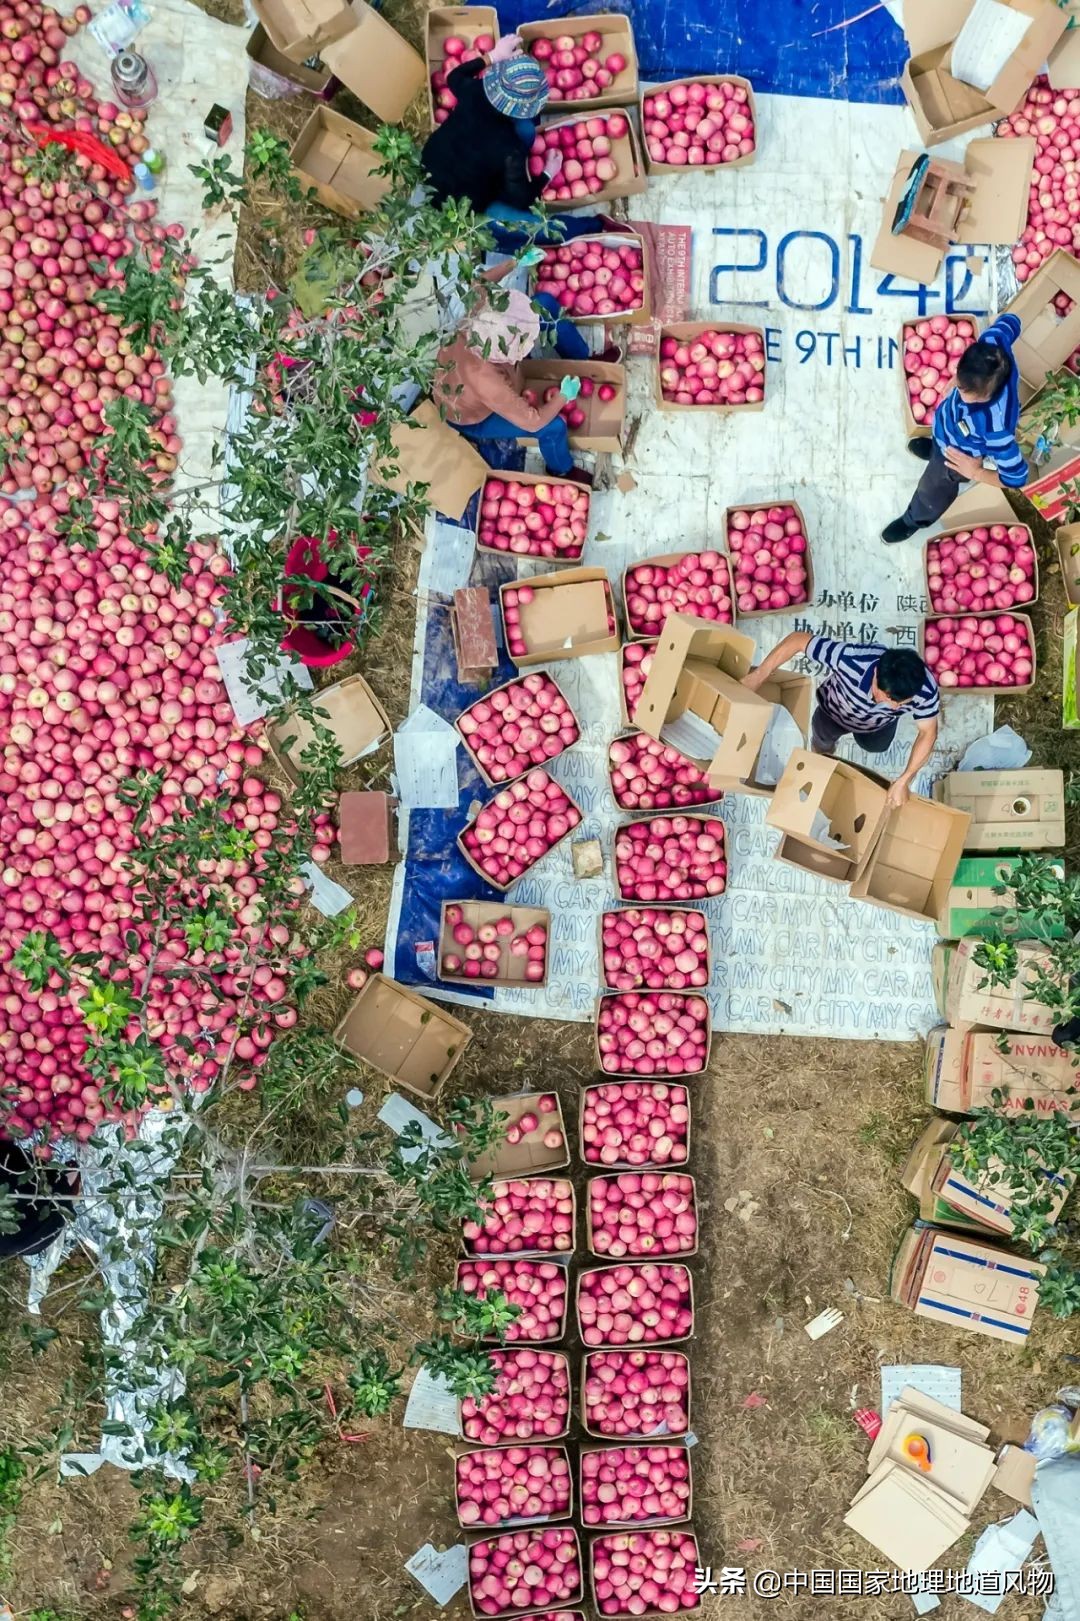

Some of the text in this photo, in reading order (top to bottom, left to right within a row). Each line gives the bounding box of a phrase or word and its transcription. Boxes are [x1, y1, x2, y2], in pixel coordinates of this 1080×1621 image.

[795, 330, 861, 368] 9TH
[808, 589, 880, 613] 办单位
[896, 625, 917, 646] 西
[563, 750, 600, 779] MY
[514, 878, 551, 905] MY
[553, 880, 600, 912] CAR
[731, 894, 778, 924] CAR
[780, 898, 817, 927] MY
[555, 913, 592, 942] MY
[735, 927, 770, 956] MY
[774, 929, 819, 959] CAR
[824, 933, 859, 961] MY
[861, 935, 911, 964] CITY
[552, 948, 589, 976] MY
[545, 980, 591, 1010] CAR
[732, 962, 768, 989] MY
[770, 964, 820, 994] CITY
[822, 967, 857, 995] MY
[862, 968, 908, 998] CAR
[725, 994, 771, 1023] CAR
[813, 1000, 864, 1029] CITY
[865, 1002, 902, 1030] MY
